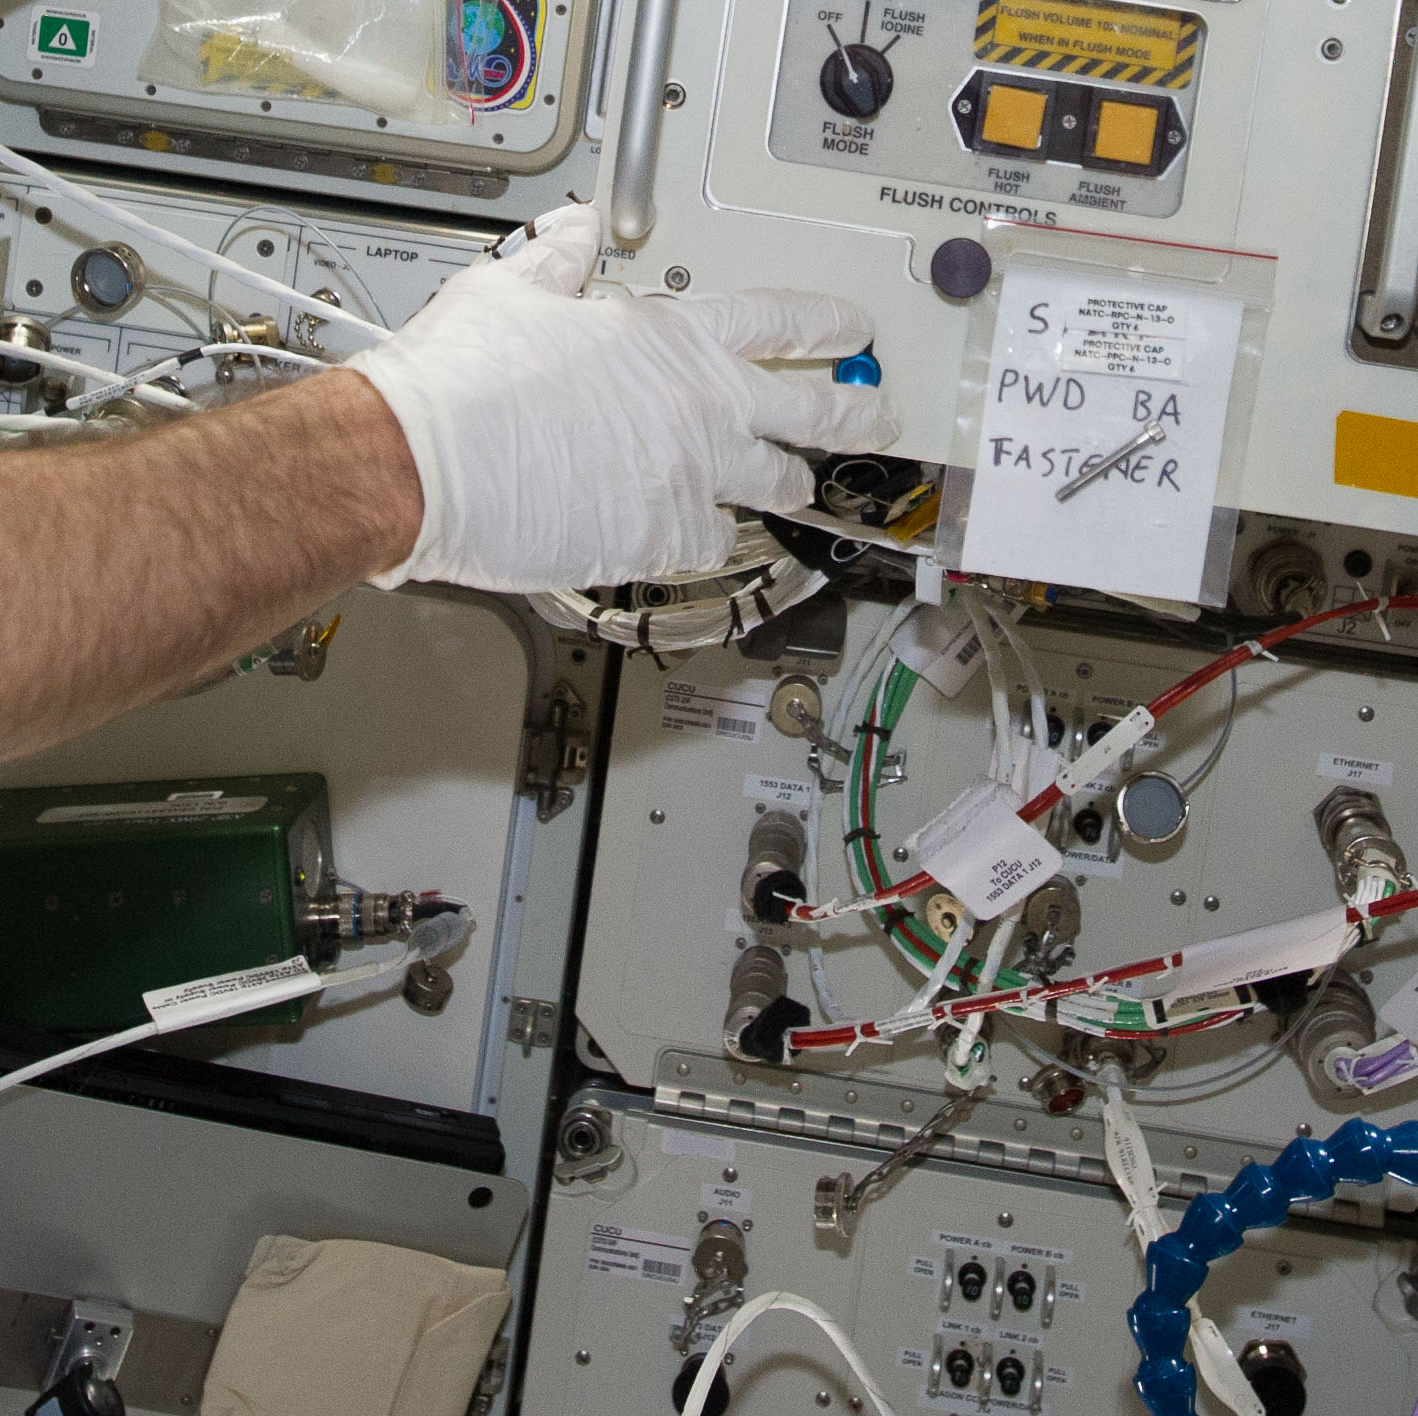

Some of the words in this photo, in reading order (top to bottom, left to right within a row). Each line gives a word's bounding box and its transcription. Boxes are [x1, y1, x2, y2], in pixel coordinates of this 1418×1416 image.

[817, 8, 844, 24] OFF
[882, 7, 926, 24] FLUSH
[999, 3, 1041, 22] FLUSH
[1042, 11, 1094, 30] VOLUME
[1119, 20, 1177, 42] NOMINAL
[880, 19, 925, 37] IODINE
[58, 32, 68, 47] 0
[1017, 30, 1055, 49] WHEN
[1056, 36, 1070, 50] IN
[1072, 38, 1113, 57] FLUSH
[1114, 43, 1153, 62] MODE
[821, 120, 875, 142] FLUSH
[821, 135, 870, 157] MODE
[987, 166, 1031, 184] FLUSH
[992, 180, 1022, 196] HOT
[1077, 180, 1122, 199] FLUSH
[878, 185, 945, 211] FLUSH
[948, 195, 1058, 227] CONTROLS
[1067, 191, 1128, 212] AMBIENT
[366, 245, 420, 263] LAPTOP
[1087, 298, 1146, 311] PROTECTIVE
[1147, 304, 1168, 313] CAP
[1111, 321, 1132, 331] QTY
[1083, 339, 1142, 353] PROTECTIVE
[1143, 345, 1165, 354] CAP
[1107, 363, 1128, 372] QTY
[997, 368, 1086, 412] PWD
[1131, 389, 1183, 427] BA
[1337, 620, 1357, 635] J2
[1332, 757, 1380, 773] ETHERNET
[759, 778, 779, 791] 1553
[780, 781, 804, 794] DATA
[991, 859, 1008, 874] P12
[1000, 860, 1023, 879] CUCU
[986, 887, 1004, 902] 1553
[1001, 872, 1024, 890] DATA
[1028, 858, 1043, 872] J12
[593, 1223, 623, 1236] CUCU
